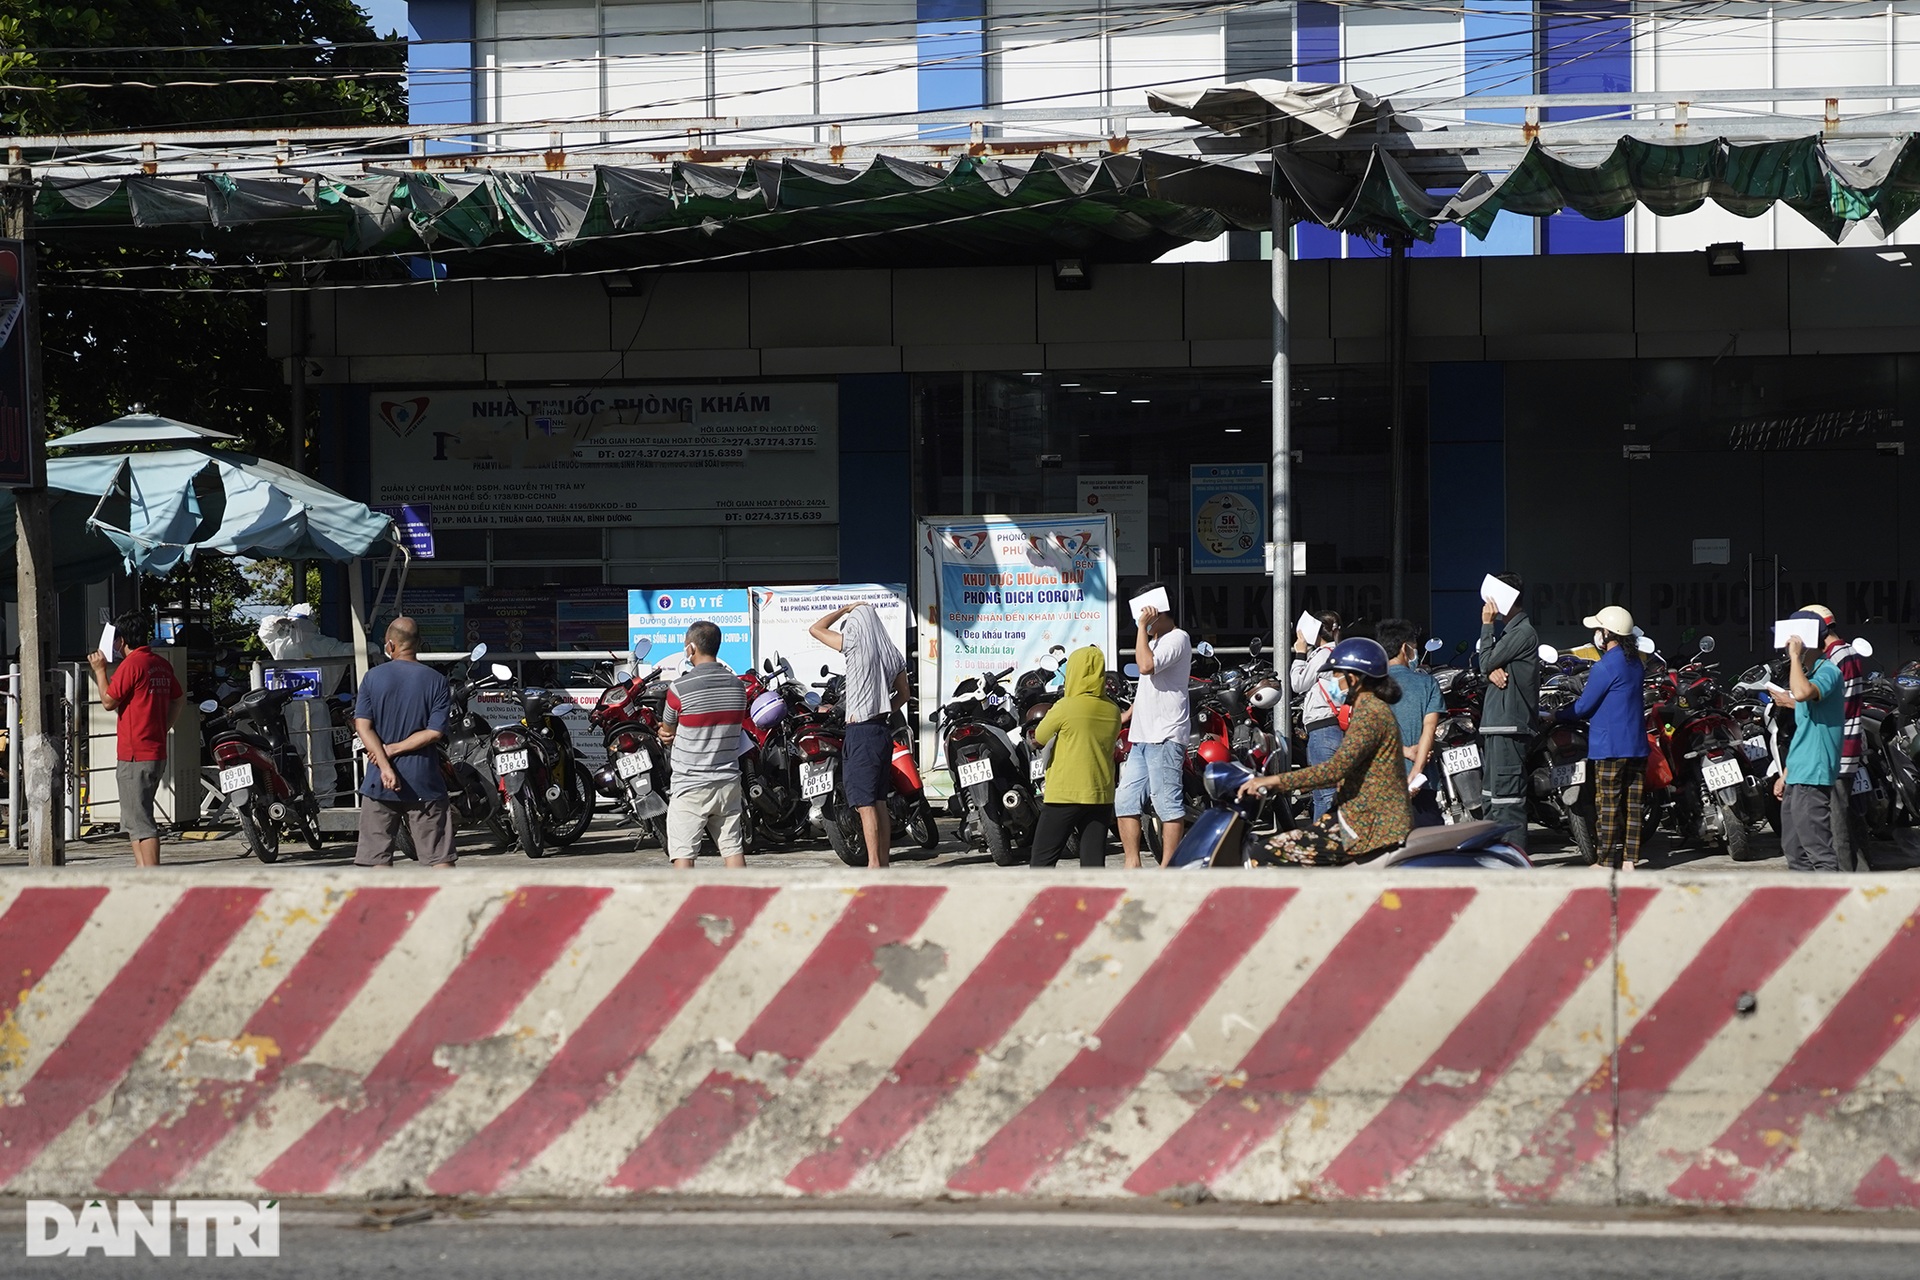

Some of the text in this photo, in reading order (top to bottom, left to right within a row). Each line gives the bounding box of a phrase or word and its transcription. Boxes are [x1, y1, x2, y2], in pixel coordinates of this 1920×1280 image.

[701, 392, 770, 413] KHÁM
[609, 437, 628, 446] GIAN
[597, 449, 615, 459] ĐT:
[380, 483, 404, 492] QUẢN
[405, 483, 416, 492] LÝ
[417, 483, 451, 492] CHUYÊN
[453, 482, 474, 492] MÔN:
[503, 481, 538, 491] NGUYỄN
[539, 482, 553, 491] THỊ
[555, 482, 572, 490] TRÀ
[573, 482, 586, 490] MY
[380, 492, 410, 501] CHỨNG
[411, 492, 426, 502] CHỈ
[427, 492, 451, 501] HÀNH
[452, 491, 475, 501] NGHỀ
[477, 491, 491, 500] SỐ:
[716, 499, 734, 507] THỜI
[735, 499, 755, 507] GIAN
[806, 498, 826, 506] 24/24
[457, 502, 469, 511] ĐỦ
[513, 502, 534, 511] KINH
[535, 502, 568, 511] DOANH:
[625, 501, 638, 509] BD
[442, 516, 455, 525] KP.
[456, 515, 472, 524] HÒA
[473, 514, 489, 524] LÂN
[490, 516, 498, 525] 1,
[499, 514, 524, 525] THUẬN
[525, 515, 546, 524] GIAO,
[546, 513, 571, 524] THUẬN
[572, 514, 586, 524] AN,
[587, 513, 606, 523] BÌNH
[724, 511, 822, 521] ĐT: 0274.3715.639
[1221, 515, 1236, 525] 5K
[962, 571, 1014, 588] KHU VỰC
[680, 593, 724, 611] BỘ Y TẾ
[963, 587, 1085, 606] PHÒNG DỊCH CORONA
[790, 603, 810, 612] PHÒNG
[810, 603, 828, 611] KHÁM
[880, 601, 900, 610] KHANG
[495, 609, 529, 617] COVID-19
[949, 609, 974, 623] BỆNH
[976, 610, 1004, 622] NHÂN
[1004, 608, 1025, 622] ĐẾN
[1057, 611, 1072, 620] VUI
[1073, 608, 1101, 620] LÒNG
[639, 615, 666, 627] Đường
[667, 615, 682, 628] dây
[707, 615, 743, 625] 19009095
[652, 630, 668, 644] SỐNG
[668, 633, 676, 644] AN
[724, 632, 749, 645] COVID-19
[955, 626, 1026, 642] 1. Đeo khẩu trang
[955, 645, 963, 655] 2.
[964, 644, 979, 655] Sát
[1002, 645, 1016, 656] tay
[954, 660, 963, 669] 3.
[500, 751, 522, 763] 61-C1
[1448, 747, 1473, 762] 67-D1
[498, 759, 527, 773] 138.49
[624, 759, 648, 775] 2341
[963, 761, 986, 775] 61-F1
[1448, 756, 1480, 773] 350.88
[1708, 762, 1734, 778] 61-C1
[224, 766, 248, 781] 69-D1
[807, 773, 829, 787] 60-C1
[961, 771, 992, 786] 336.76
[1708, 770, 1741, 789] 968.31
[223, 774, 252, 792] 167.90
